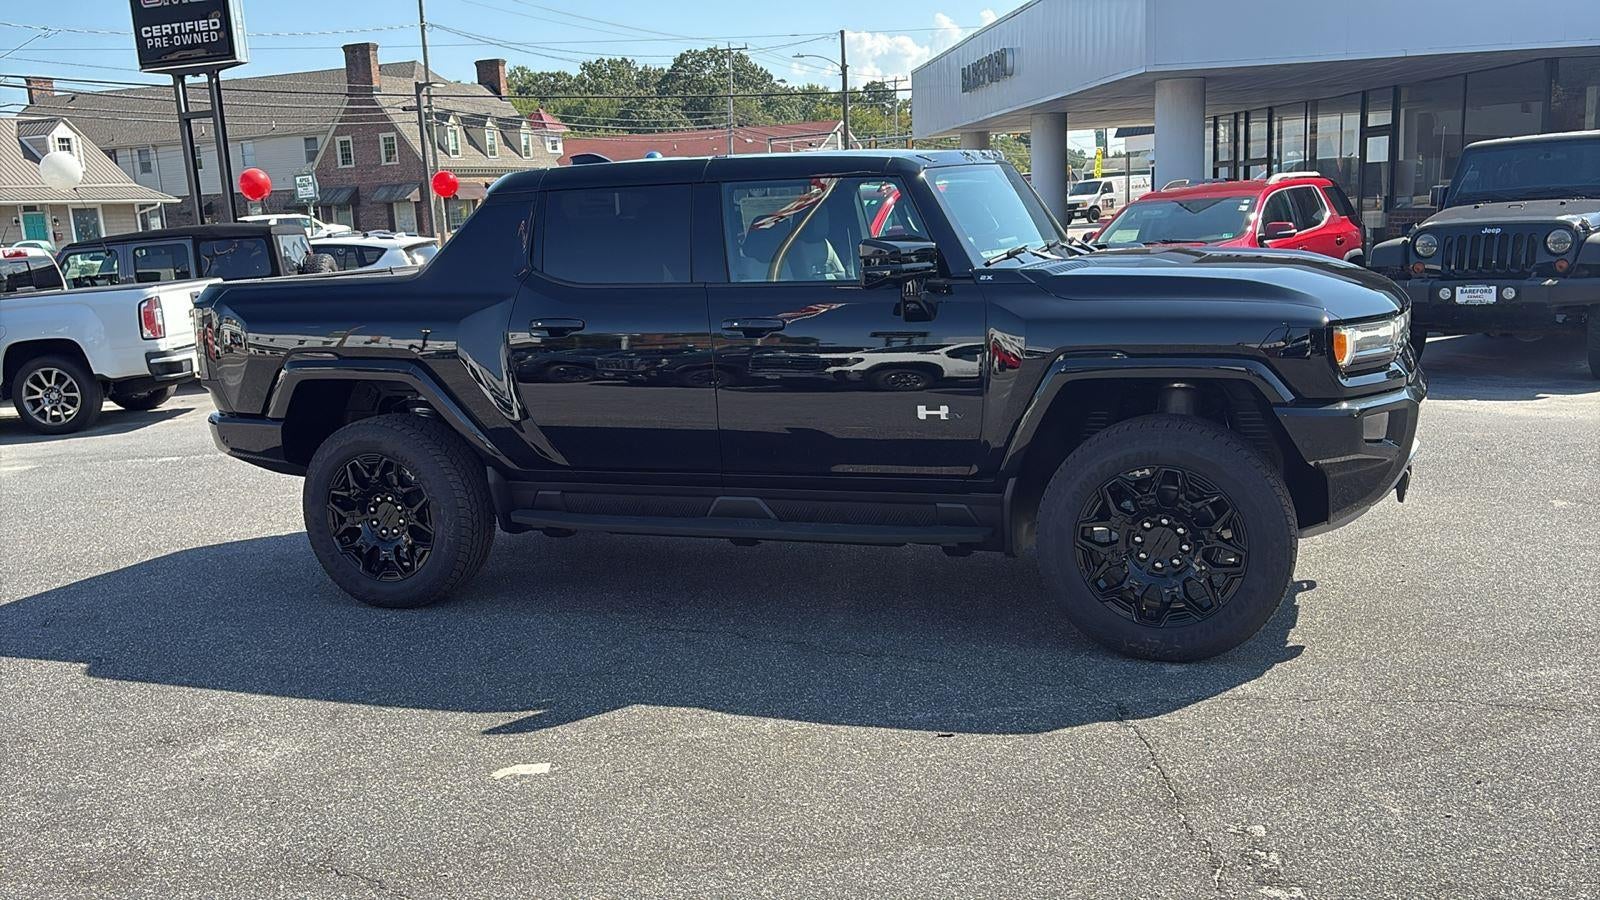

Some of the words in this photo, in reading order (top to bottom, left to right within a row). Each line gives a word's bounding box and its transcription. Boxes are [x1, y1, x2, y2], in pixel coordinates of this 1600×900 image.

[141, 19, 221, 38] CERTIFIED
[146, 31, 218, 49] PRE-OWNED
[961, 47, 1015, 93] BAREFORD
[1481, 227, 1502, 235] Jeep
